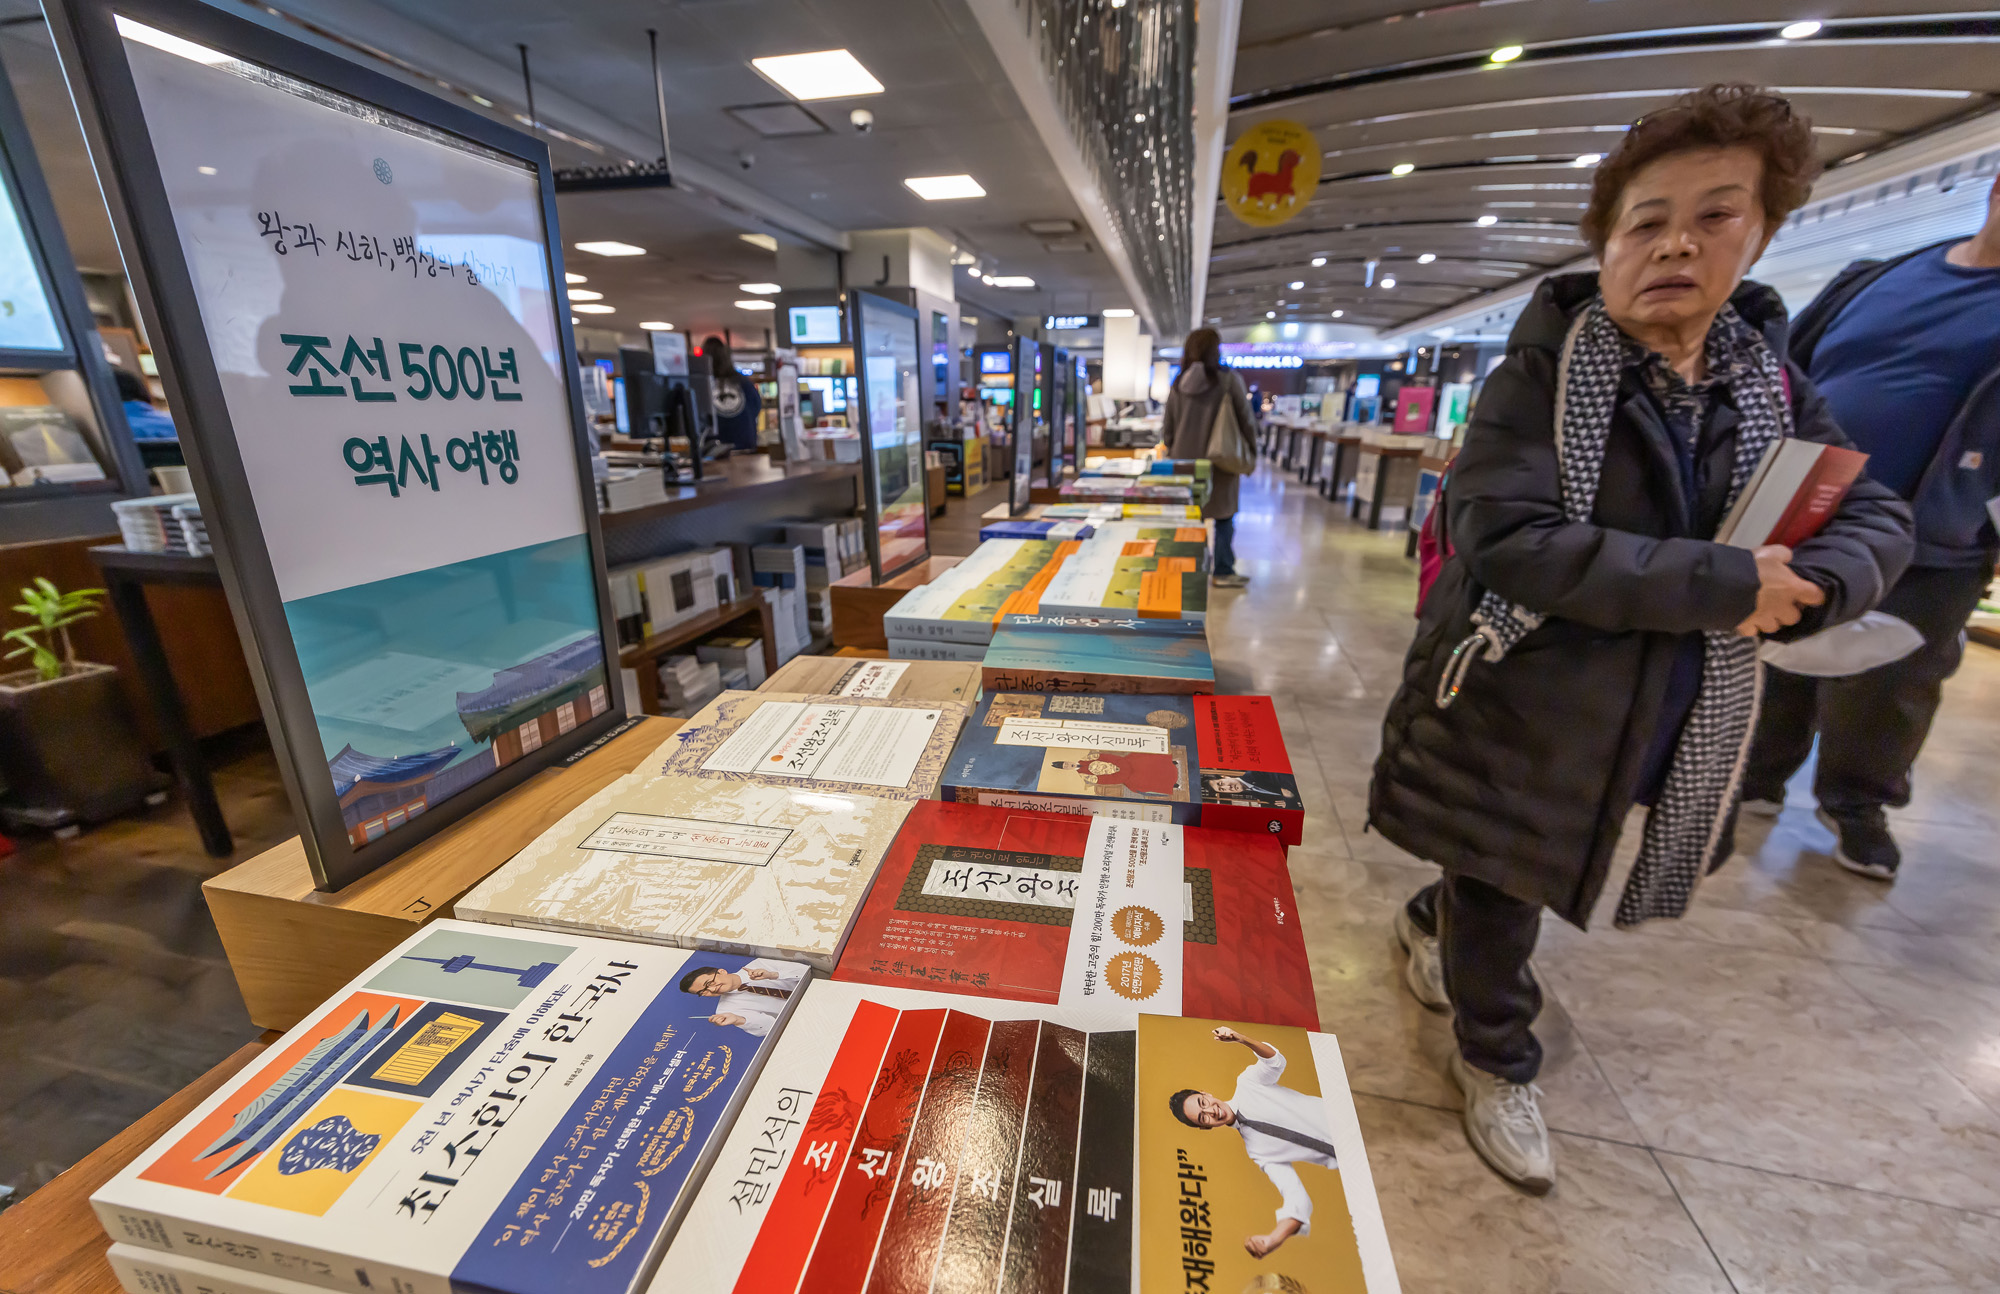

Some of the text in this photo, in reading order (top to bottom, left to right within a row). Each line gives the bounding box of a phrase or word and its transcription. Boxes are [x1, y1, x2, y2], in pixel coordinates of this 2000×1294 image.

[258, 211, 326, 255] 왕과
[280, 333, 523, 402] 조선 500년
[342, 429, 520, 498] 역사 여행
[787, 708, 846, 771] 조선왕조실록
[1011, 730, 1151, 748] 조선왕조실록
[607, 825, 770, 849] 단종의 비애 세종의 눈물
[952, 849, 1044, 865] 한 권으로 읽는
[1101, 850, 1112, 873] 오리지널
[1127, 850, 1137, 868] 500년을
[1098, 874, 1111, 890] 인정한
[1126, 868, 1134, 888] 조선왕조
[1096, 890, 1108, 910] 독자가
[1090, 932, 1103, 942] 힘!
[1094, 911, 1105, 932] 200만
[1087, 944, 1100, 969] 고증의
[1120, 960, 1131, 988] 2017년
[1083, 970, 1097, 996] 탄탄한
[1132, 957, 1144, 994] 전면개정판
[410, 983, 572, 1155] 5천 년 역사가 단숨에 이해되는
[683, 1051, 715, 1092] 한국사 교과서
[702, 1065, 716, 1080] 저자
[395, 959, 639, 1225] 최소한의 한국사
[520, 1212, 550, 1246] 역사
[545, 1163, 583, 1208] 공부가
[578, 1145, 597, 1160] 더
[592, 1115, 616, 1141] 쉽고
[612, 1055, 659, 1111] 재미있었을
[569, 1050, 688, 1220] 20만 독자가 선택한 역사 베스트셀러
[636, 1109, 678, 1168] 700만이 열광한
[649, 1115, 686, 1166] 한국사 명강의
[729, 1086, 814, 1216] 설민석의
[493, 1077, 625, 1246] “이 책이 역사 교과서였다면
[802, 1139, 1122, 1223] 조선왕조실록
[593, 1222, 609, 1240] 3년
[605, 1203, 634, 1242] 역사 1위
[1176, 1148, 1215, 1294] 재해왔다!”
[184, 1231, 260, 1259] 최소한의
